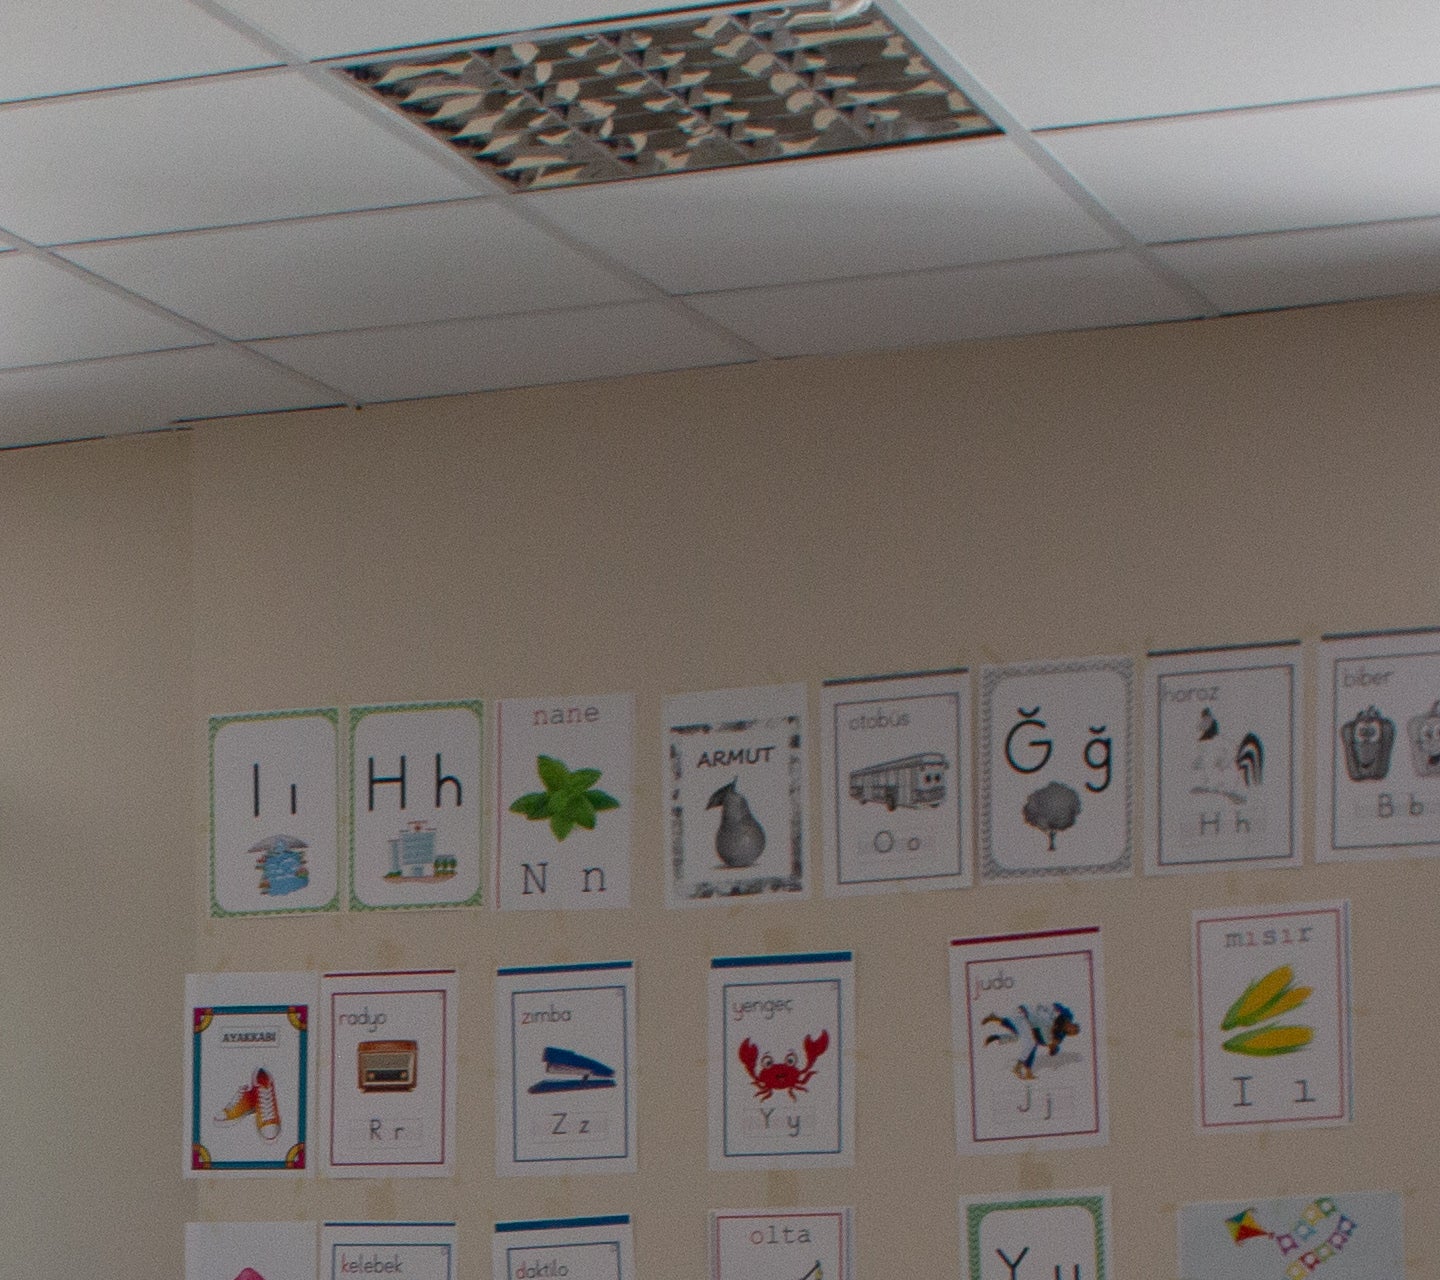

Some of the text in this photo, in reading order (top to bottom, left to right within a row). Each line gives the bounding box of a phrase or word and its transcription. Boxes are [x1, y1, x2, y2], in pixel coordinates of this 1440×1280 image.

[1344, 668, 1392, 687] biber
[1163, 683, 1219, 703] horoz
[534, 707, 599, 726] nane
[850, 711, 909, 730] otobüs
[697, 746, 774, 767] ARMUT
[1004, 707, 1112, 793] Ğ ğ
[369, 754, 462, 810] H h
[1378, 793, 1424, 818] B b
[1199, 811, 1251, 836] H h
[522, 862, 605, 895] N n
[975, 972, 1014, 1000] judo
[337, 1008, 387, 1032] radyo
[521, 1005, 572, 1026] zımba
[1016, 1084, 1033, 1113] J
[552, 1112, 567, 1135] Z
[760, 1108, 777, 1131] Y
[751, 1225, 811, 1245] olta
[340, 1254, 404, 1274] kelebek
[515, 1260, 569, 1280] daktilo
